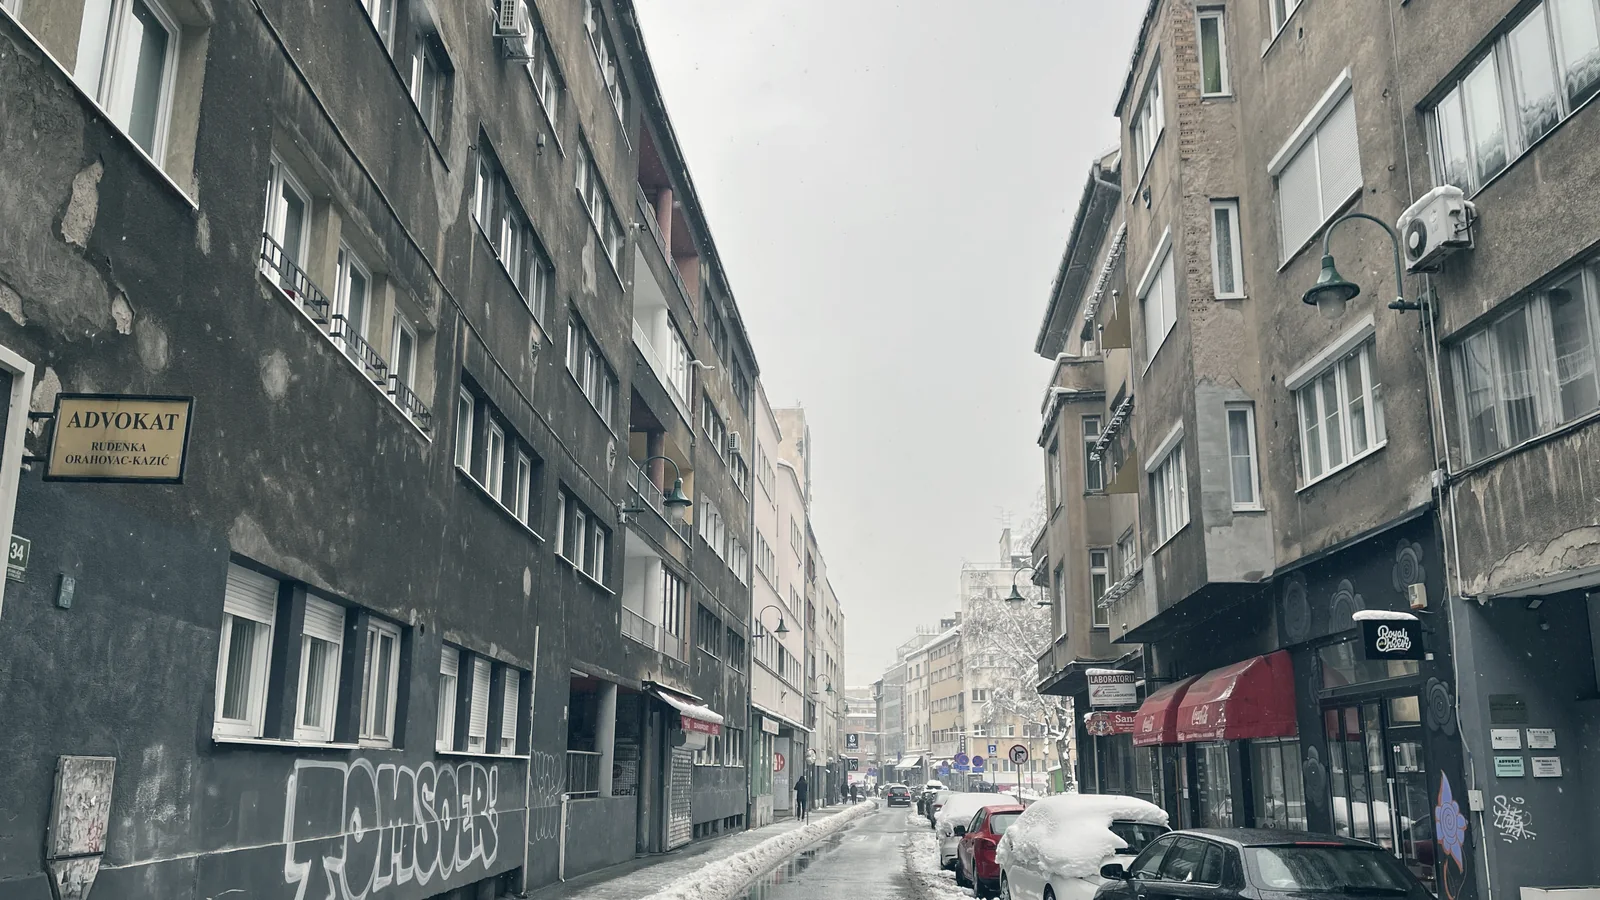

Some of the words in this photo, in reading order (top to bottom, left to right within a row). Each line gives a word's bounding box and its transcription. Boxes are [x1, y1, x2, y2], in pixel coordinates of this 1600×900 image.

[67, 411, 179, 431] ADVOKAT
[91, 442, 146, 452] RUDENKA
[65, 454, 170, 466] ORAHOVAC-KAZIĆ
[10, 542, 24, 561] 34
[1378, 625, 1408, 641] Royal
[1090, 675, 1135, 684] LABORATORIJ
